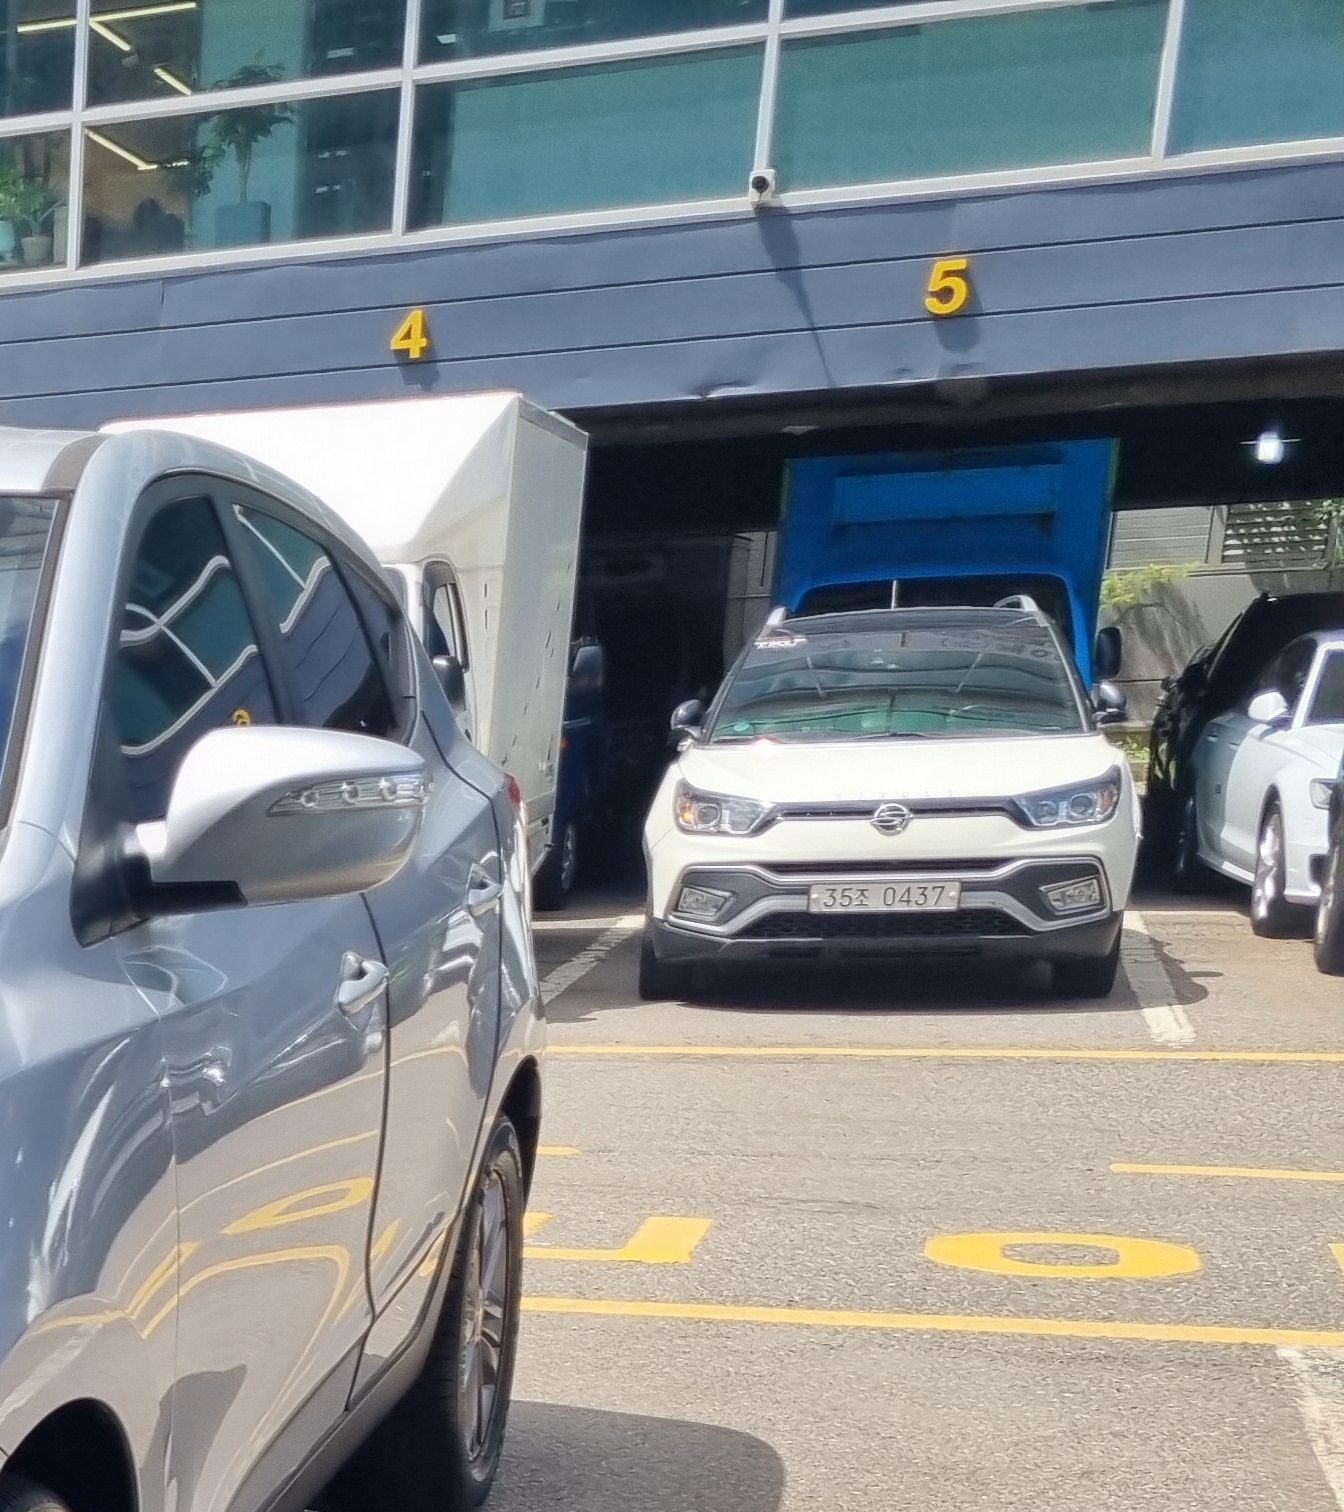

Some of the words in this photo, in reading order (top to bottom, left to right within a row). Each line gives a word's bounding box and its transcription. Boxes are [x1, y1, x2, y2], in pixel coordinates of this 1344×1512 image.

[925, 258, 968, 315] 5
[390, 309, 428, 358] 4
[823, 887, 869, 907] 35조
[883, 886, 945, 907] 0437
